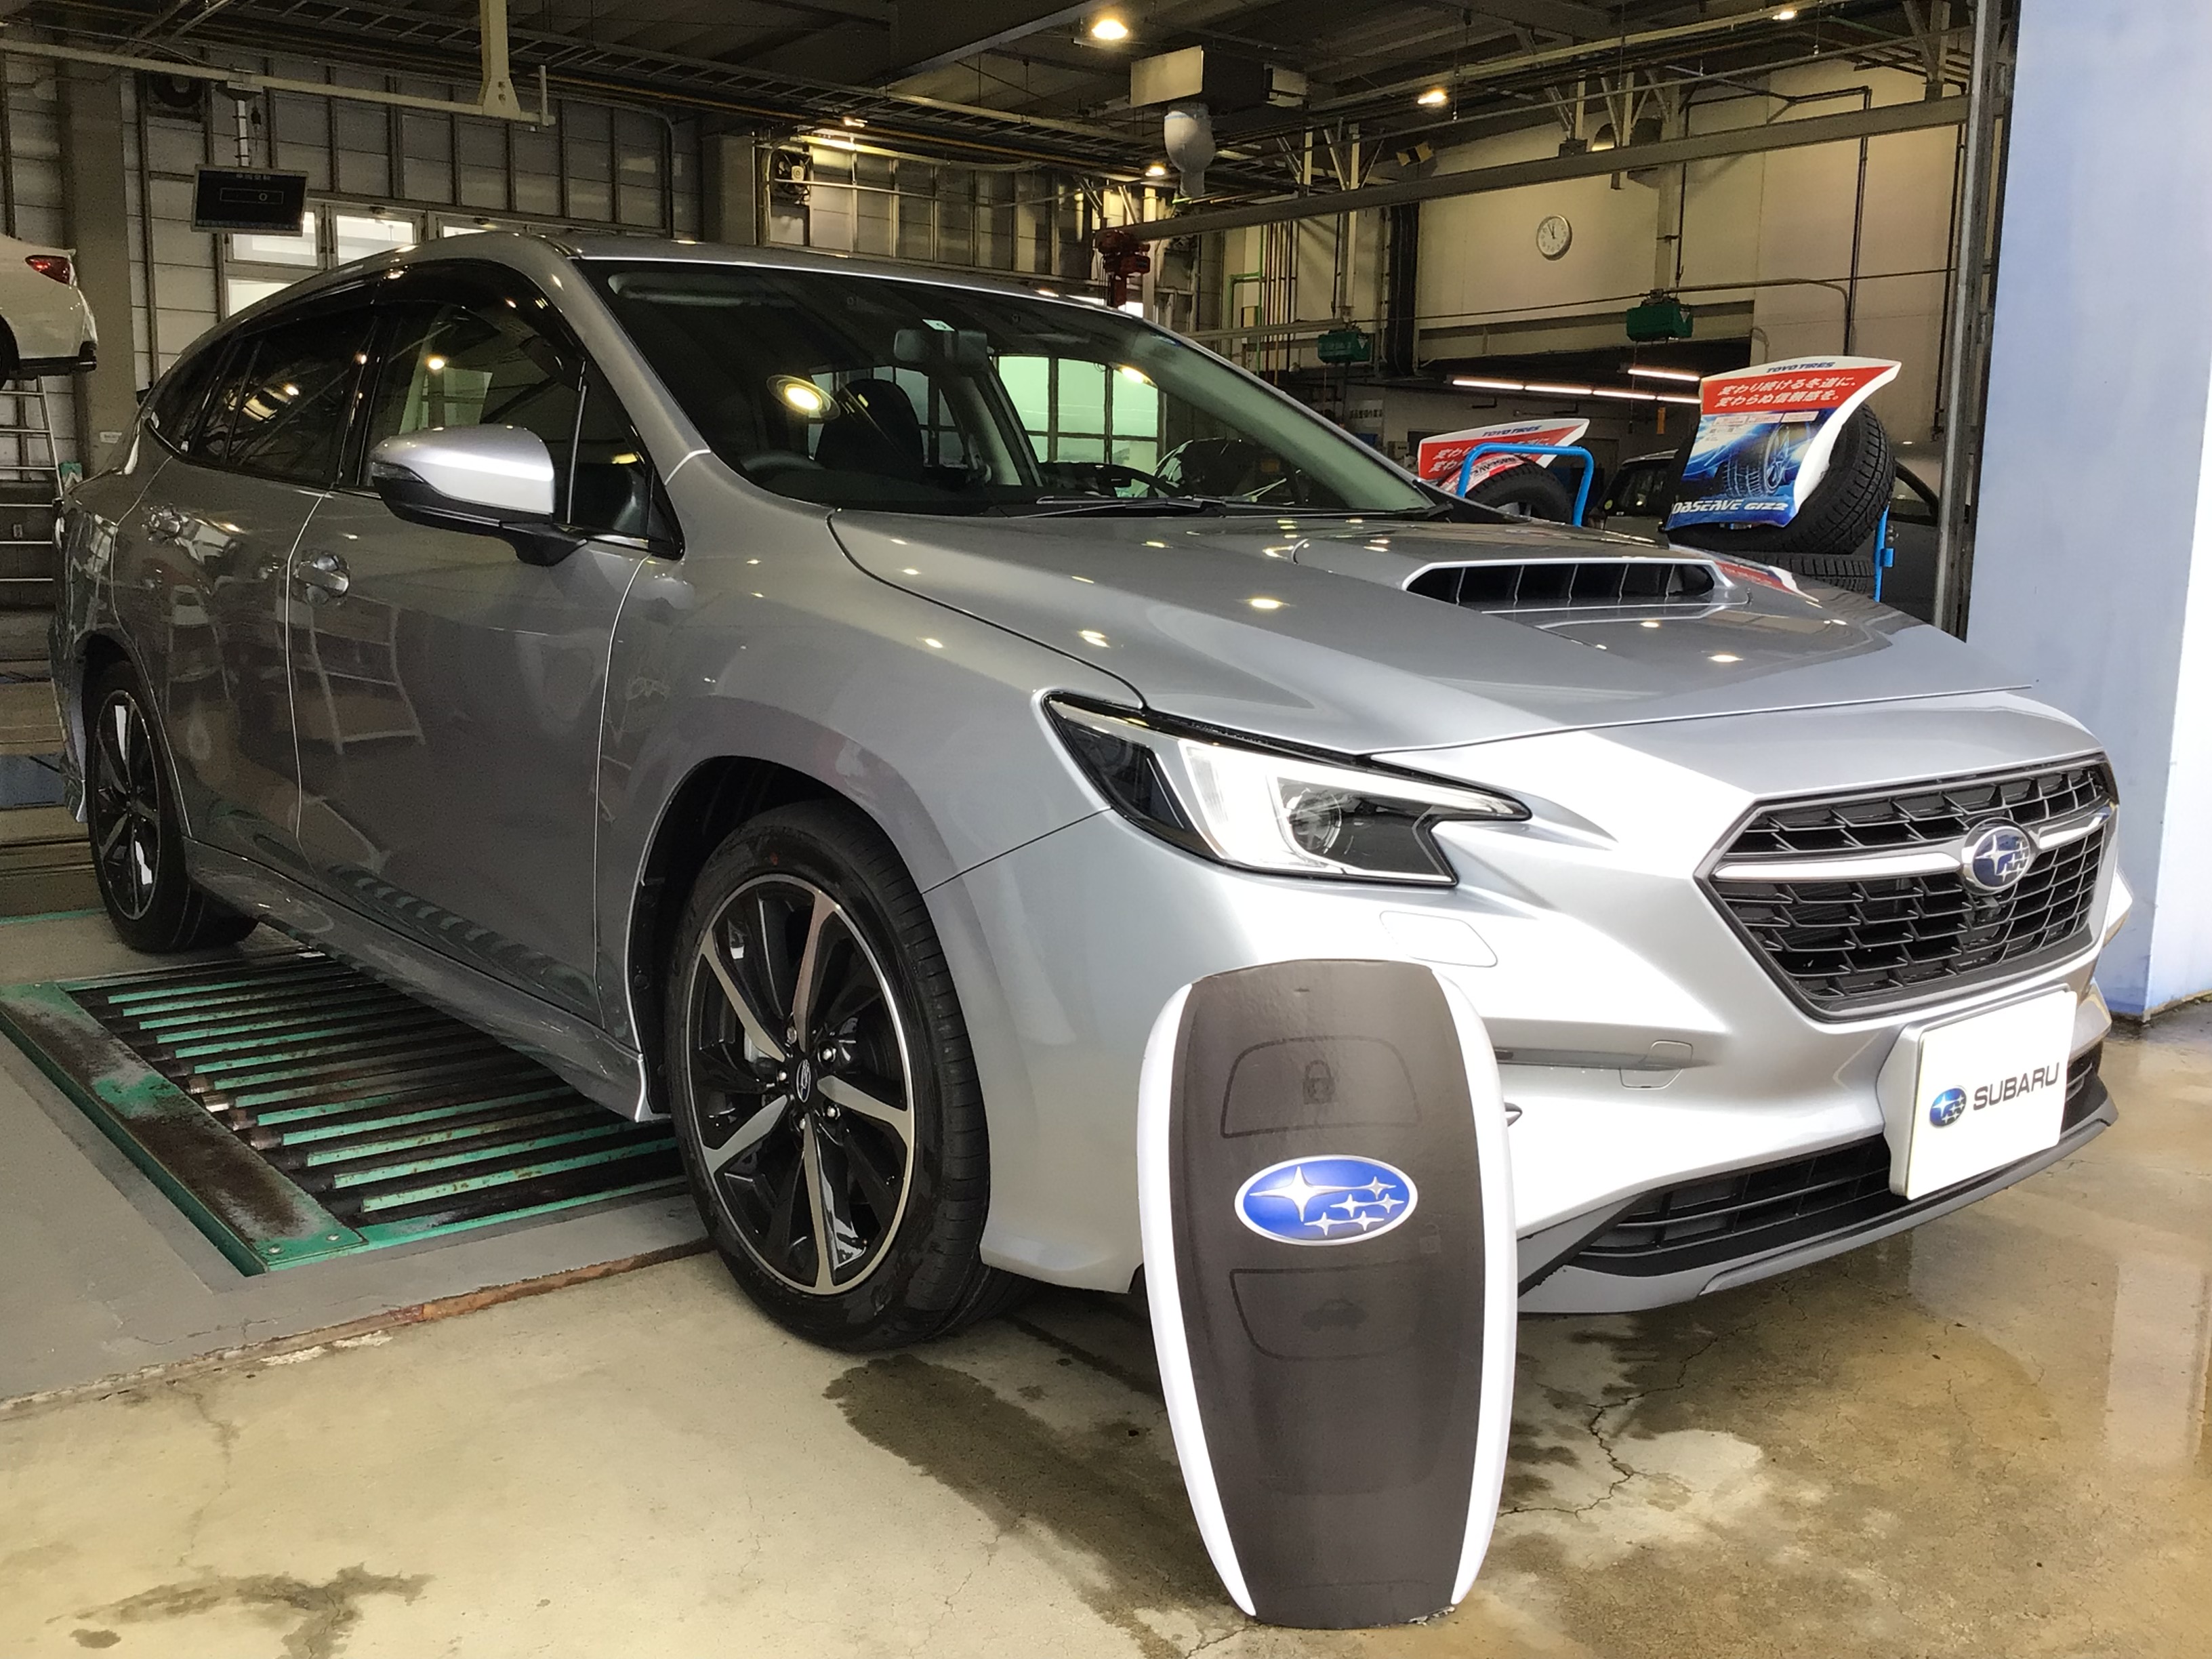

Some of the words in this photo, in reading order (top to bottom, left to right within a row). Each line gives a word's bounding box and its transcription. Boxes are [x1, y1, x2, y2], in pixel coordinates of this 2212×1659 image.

[1766, 364, 1797, 373] TOYO
[1798, 361, 1836, 369] TIRES
[1671, 498, 1744, 515] OBSERVE
[1743, 501, 1789, 511] GIZ2
[1973, 1061, 2060, 1111] SUBARU
